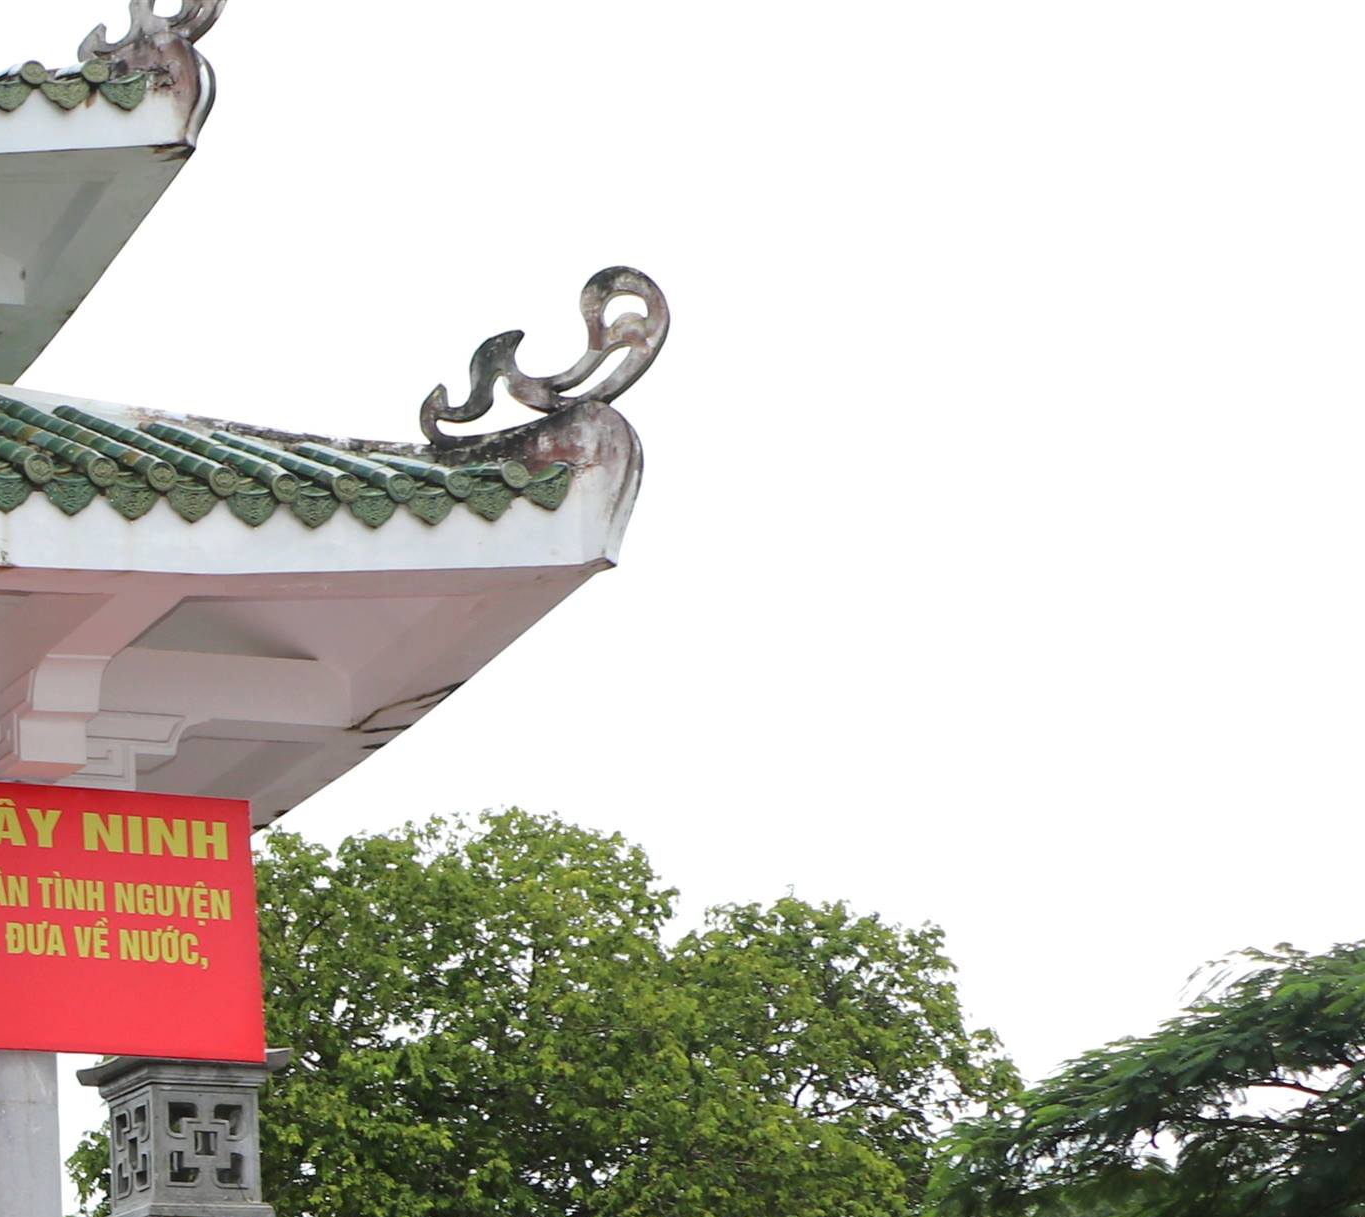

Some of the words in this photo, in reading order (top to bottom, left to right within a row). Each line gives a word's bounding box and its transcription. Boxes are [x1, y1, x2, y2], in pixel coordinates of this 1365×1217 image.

[83, 812, 229, 861] NINH
[36, 871, 106, 913] TÌNH
[113, 880, 233, 923] NGUYỆN
[5, 920, 68, 957] ĐƯA
[73, 917, 111, 959] VỀ
[118, 923, 210, 969] NƯỚC,
